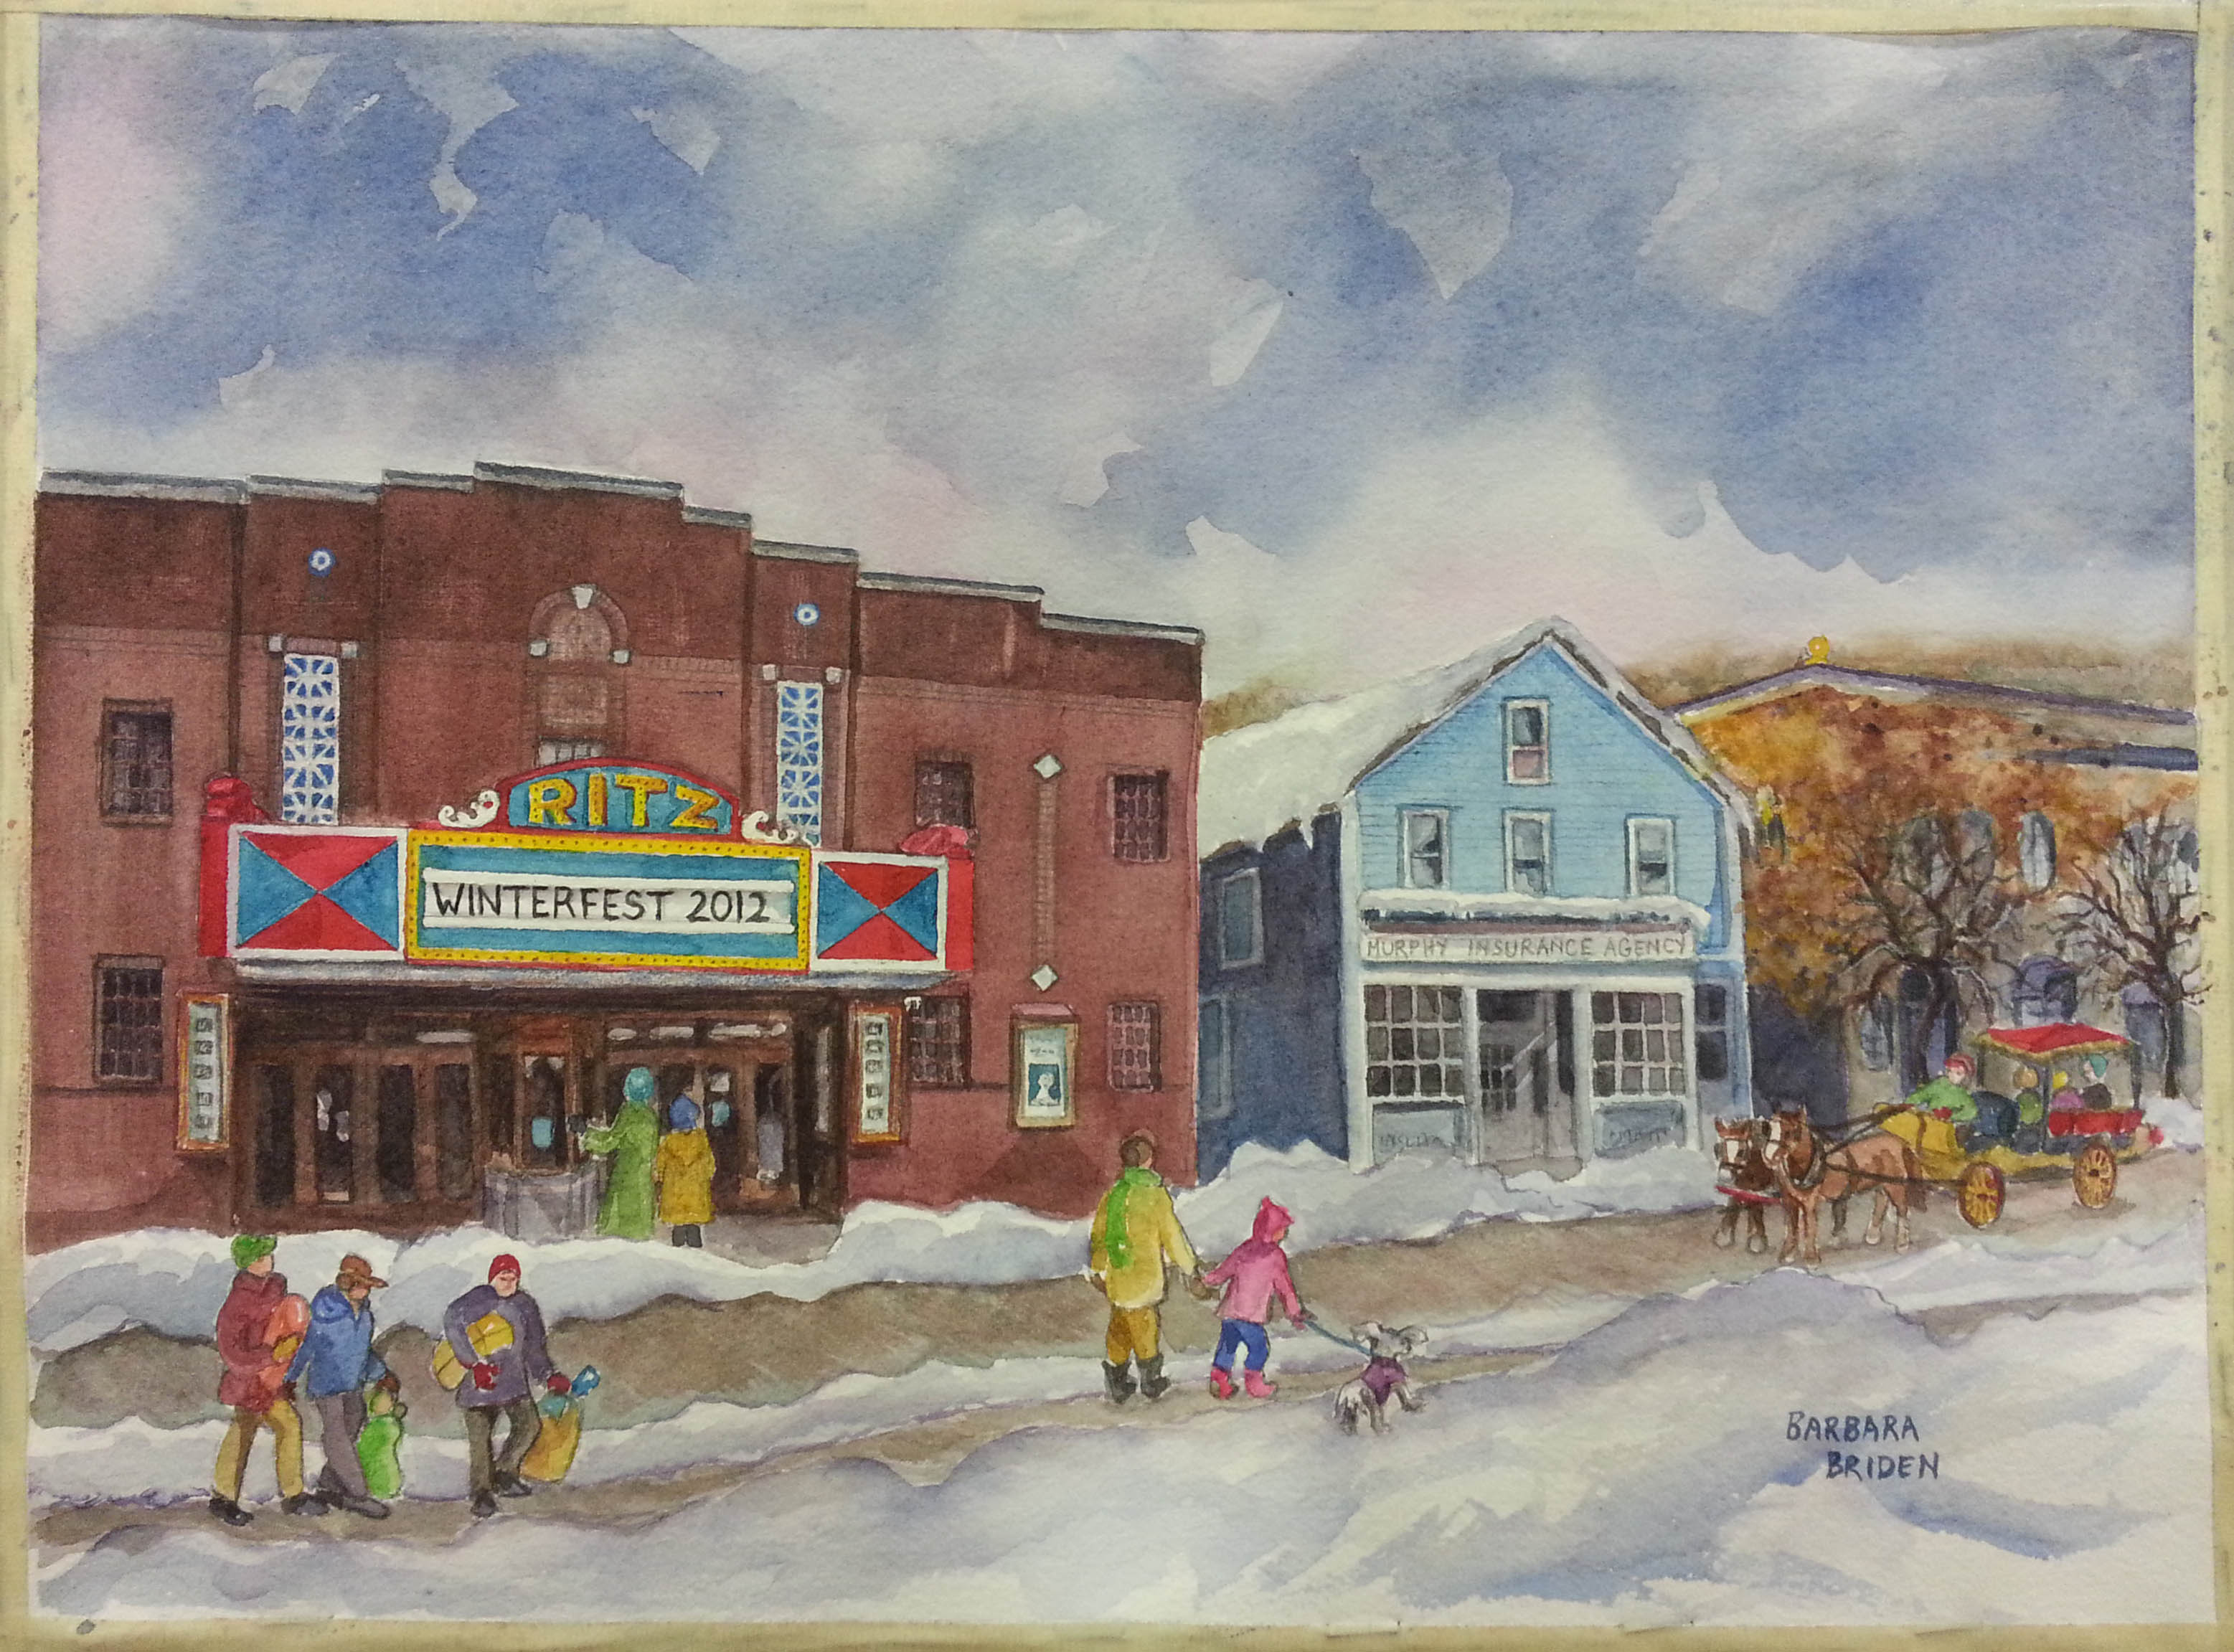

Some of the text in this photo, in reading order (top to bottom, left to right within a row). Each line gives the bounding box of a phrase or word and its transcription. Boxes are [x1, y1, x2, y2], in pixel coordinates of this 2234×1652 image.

[528, 773, 720, 830] RITZ
[432, 882, 770, 923] WINTERFEST 2012
[1367, 934, 1685, 959] MURPHY INSURANCE AGENCY
[1786, 1410, 1920, 1443] BARBARA
[1826, 1451, 1939, 1481] BRIDEN
